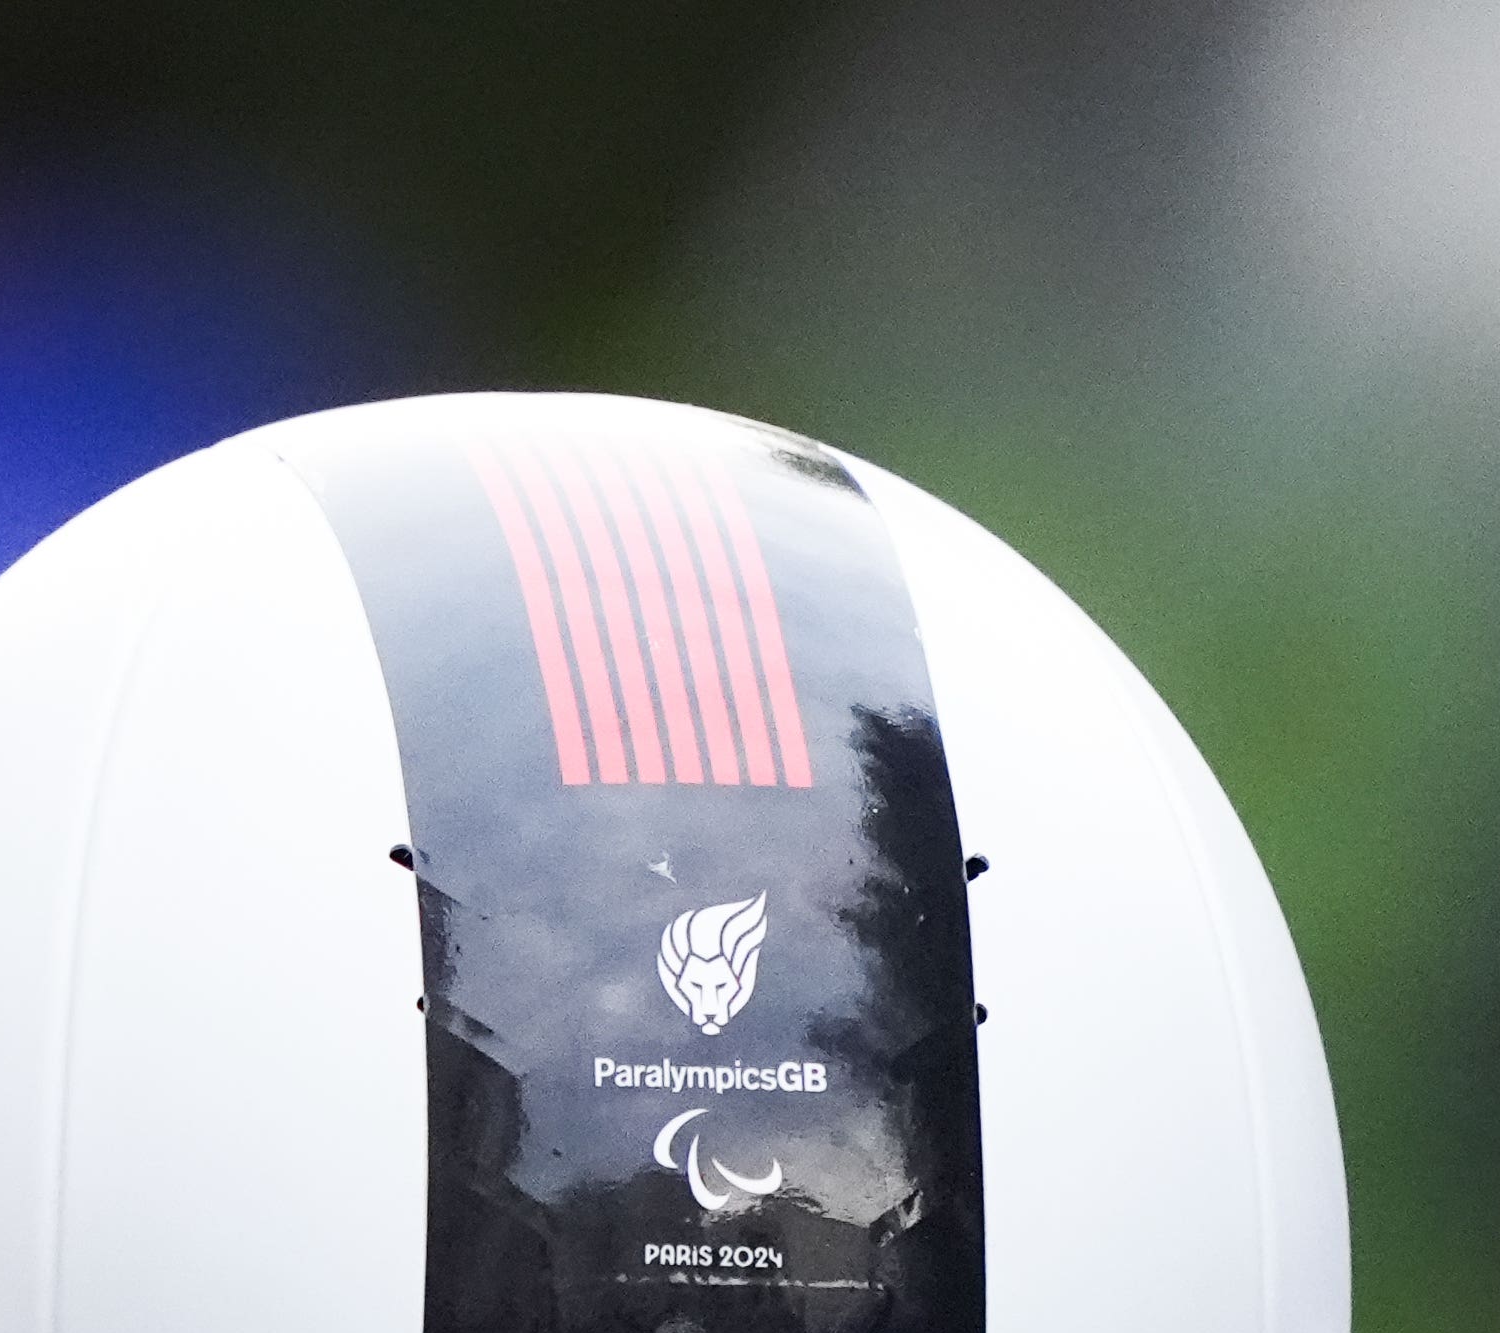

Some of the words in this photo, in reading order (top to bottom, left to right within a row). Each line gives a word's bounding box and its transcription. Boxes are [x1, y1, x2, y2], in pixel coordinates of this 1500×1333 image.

[593, 1057, 828, 1094] ParalympicsGB
[644, 1243, 713, 1267] PARIS
[718, 1245, 784, 1269] 2024
